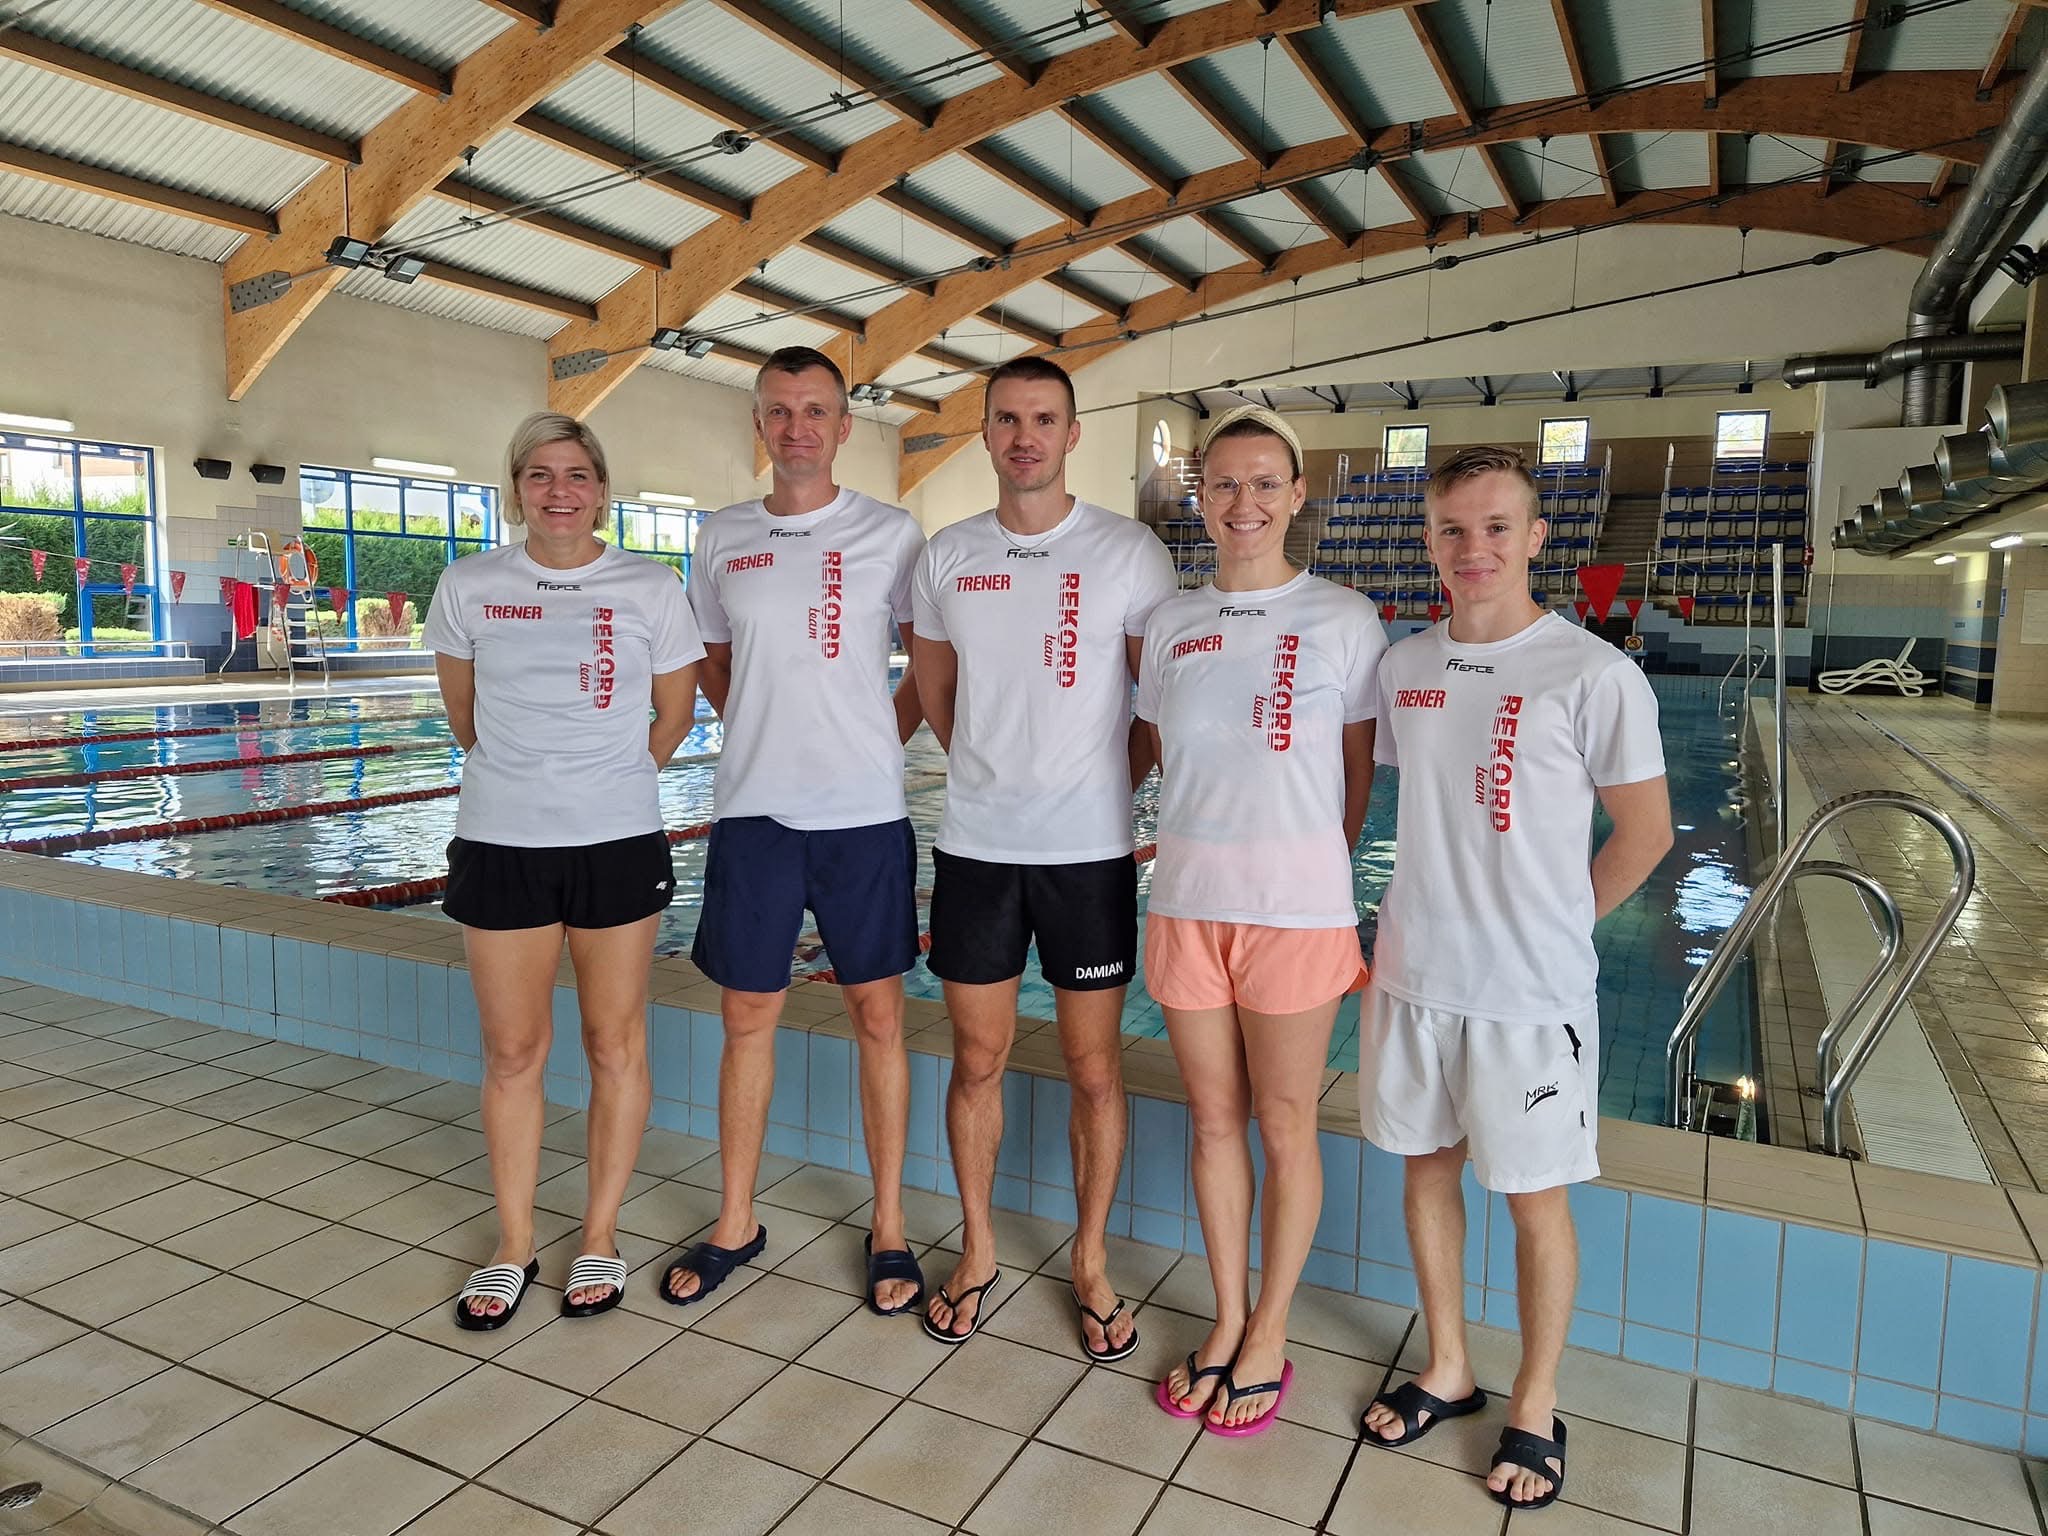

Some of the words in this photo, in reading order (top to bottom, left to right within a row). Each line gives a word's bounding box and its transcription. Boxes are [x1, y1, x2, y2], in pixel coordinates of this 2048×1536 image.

[727, 553, 774, 572] TRENER
[957, 574, 1012, 592] TRENER
[484, 605, 543, 620] TRENER
[822, 551, 843, 659] REKORD
[808, 606, 820, 640] team
[1057, 572, 1081, 688] REKORD
[592, 607, 617, 709] REKORD
[1044, 633, 1057, 667] team
[1173, 634, 1224, 657] TRENER
[1268, 634, 1300, 752] REKORD
[1395, 688, 1447, 709] TRENER
[1252, 694, 1268, 730] team
[1489, 694, 1524, 833] REKORD
[1474, 764, 1489, 806] team
[1075, 962, 1123, 980] DAMIAN
